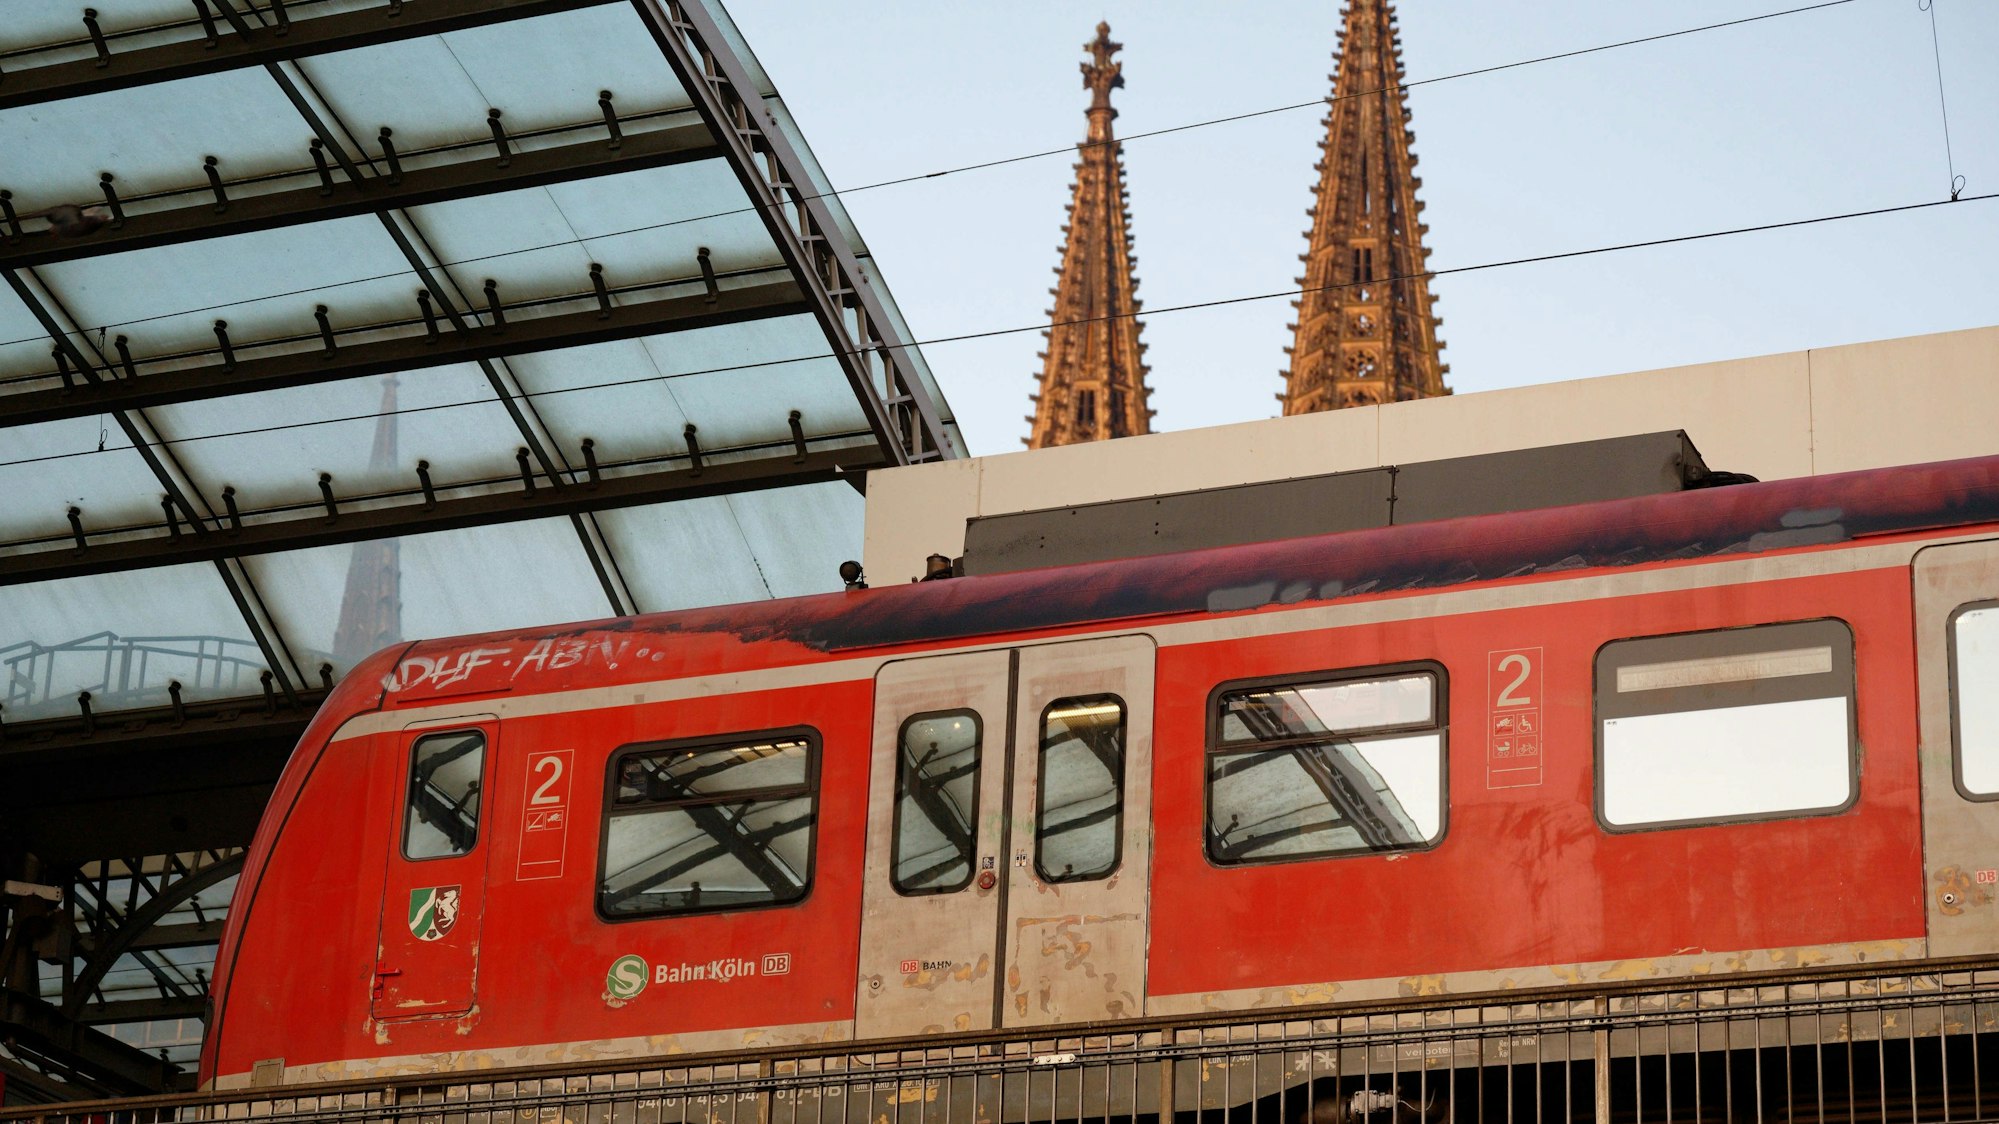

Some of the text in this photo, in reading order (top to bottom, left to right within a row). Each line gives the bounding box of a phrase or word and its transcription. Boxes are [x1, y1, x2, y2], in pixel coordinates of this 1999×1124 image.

[1496, 654, 1531, 707] 2
[530, 755, 563, 805] 2
[1977, 870, 1996, 883] DB
[613, 955, 789, 995] S Bahn Köln DB
[901, 960, 952, 973] DB BAHN
[1499, 1039, 1520, 1047] Reon
